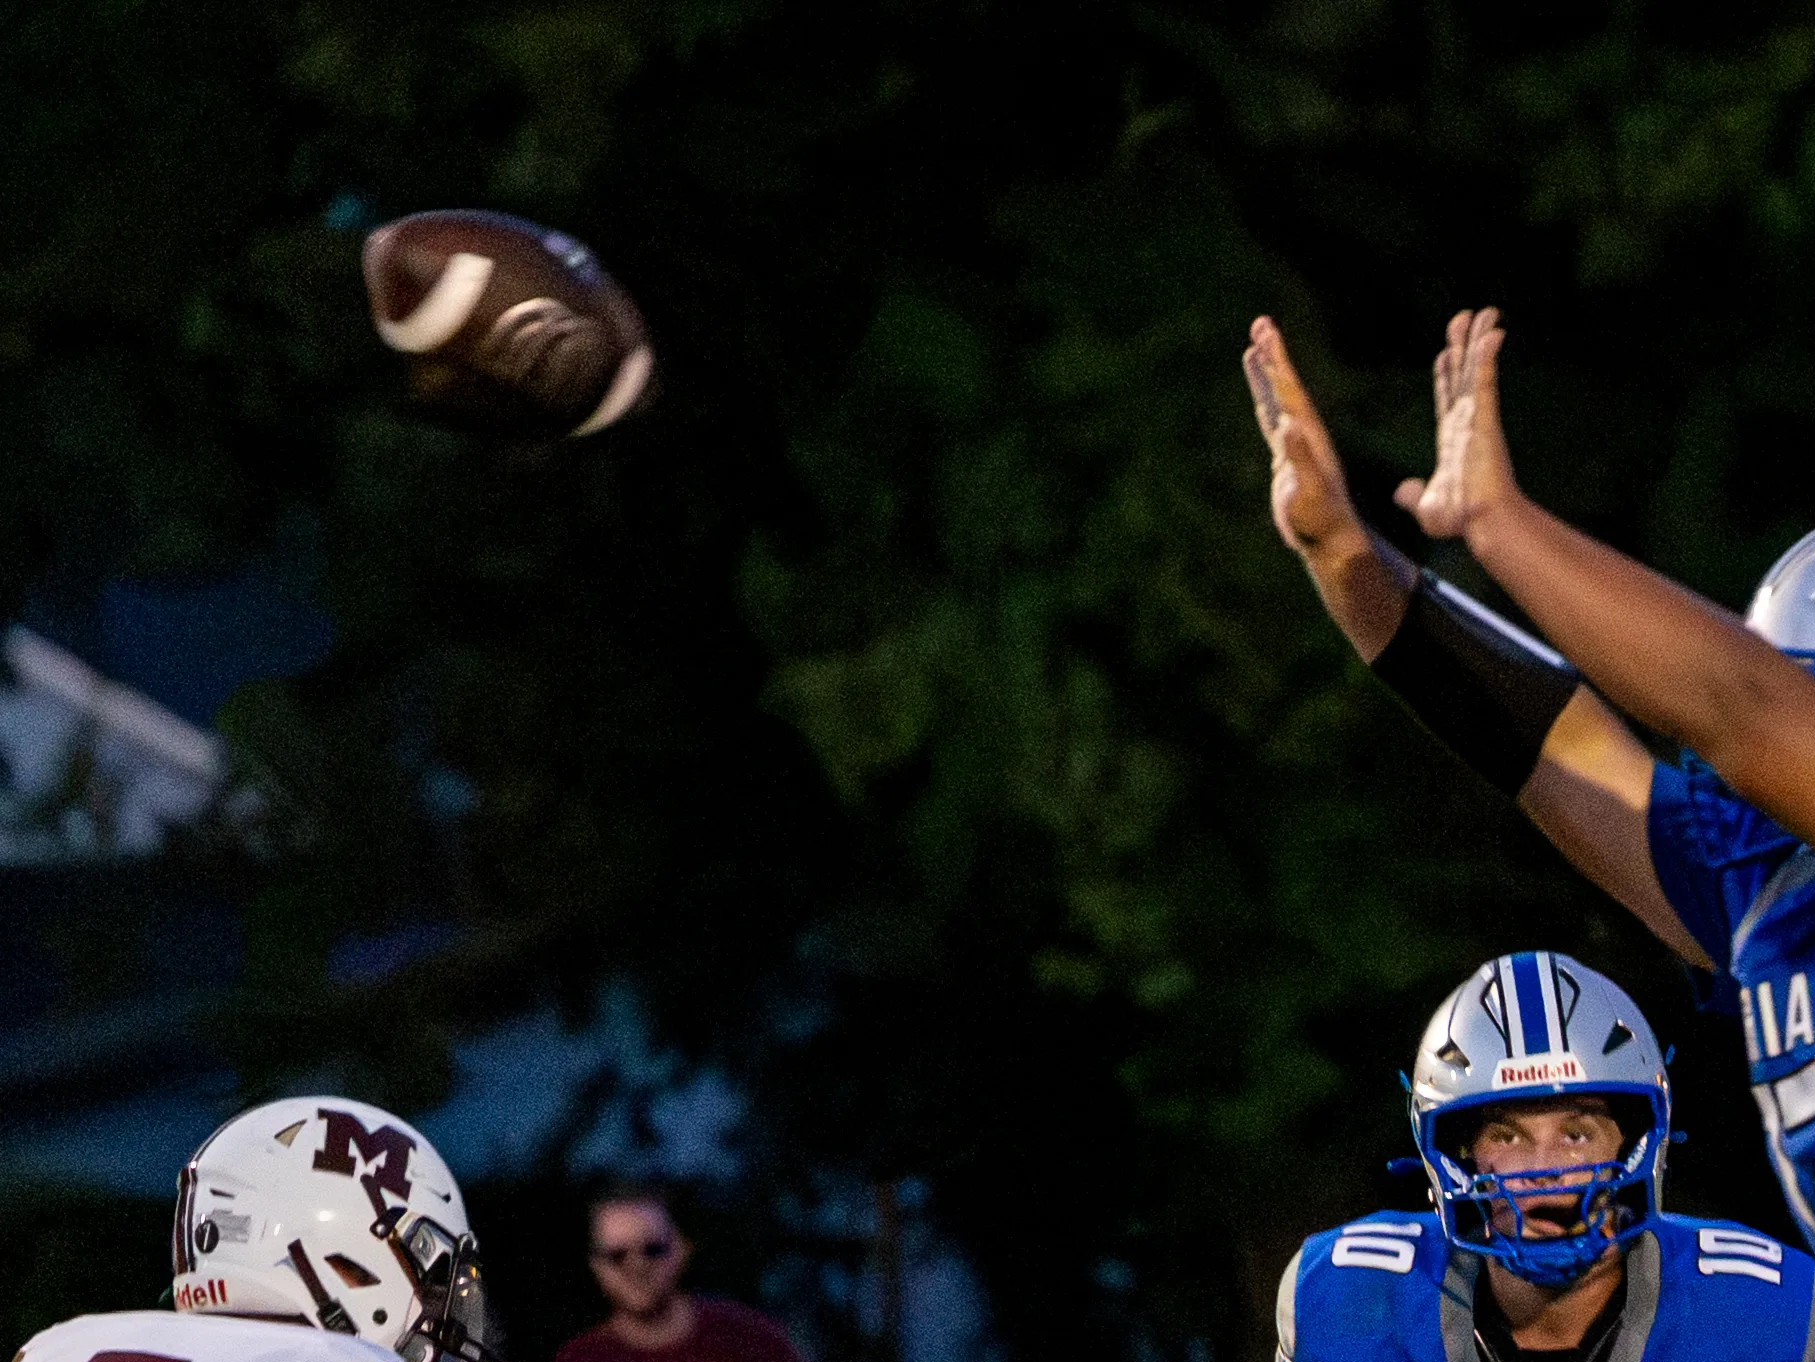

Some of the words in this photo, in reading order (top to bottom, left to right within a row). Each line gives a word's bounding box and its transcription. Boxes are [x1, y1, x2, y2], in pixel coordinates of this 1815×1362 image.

[1501, 1061, 1577, 1084] Riddell
[312, 1107, 417, 1202] M
[1331, 1222, 1423, 1274] 10
[1698, 1228, 1783, 1286] 10
